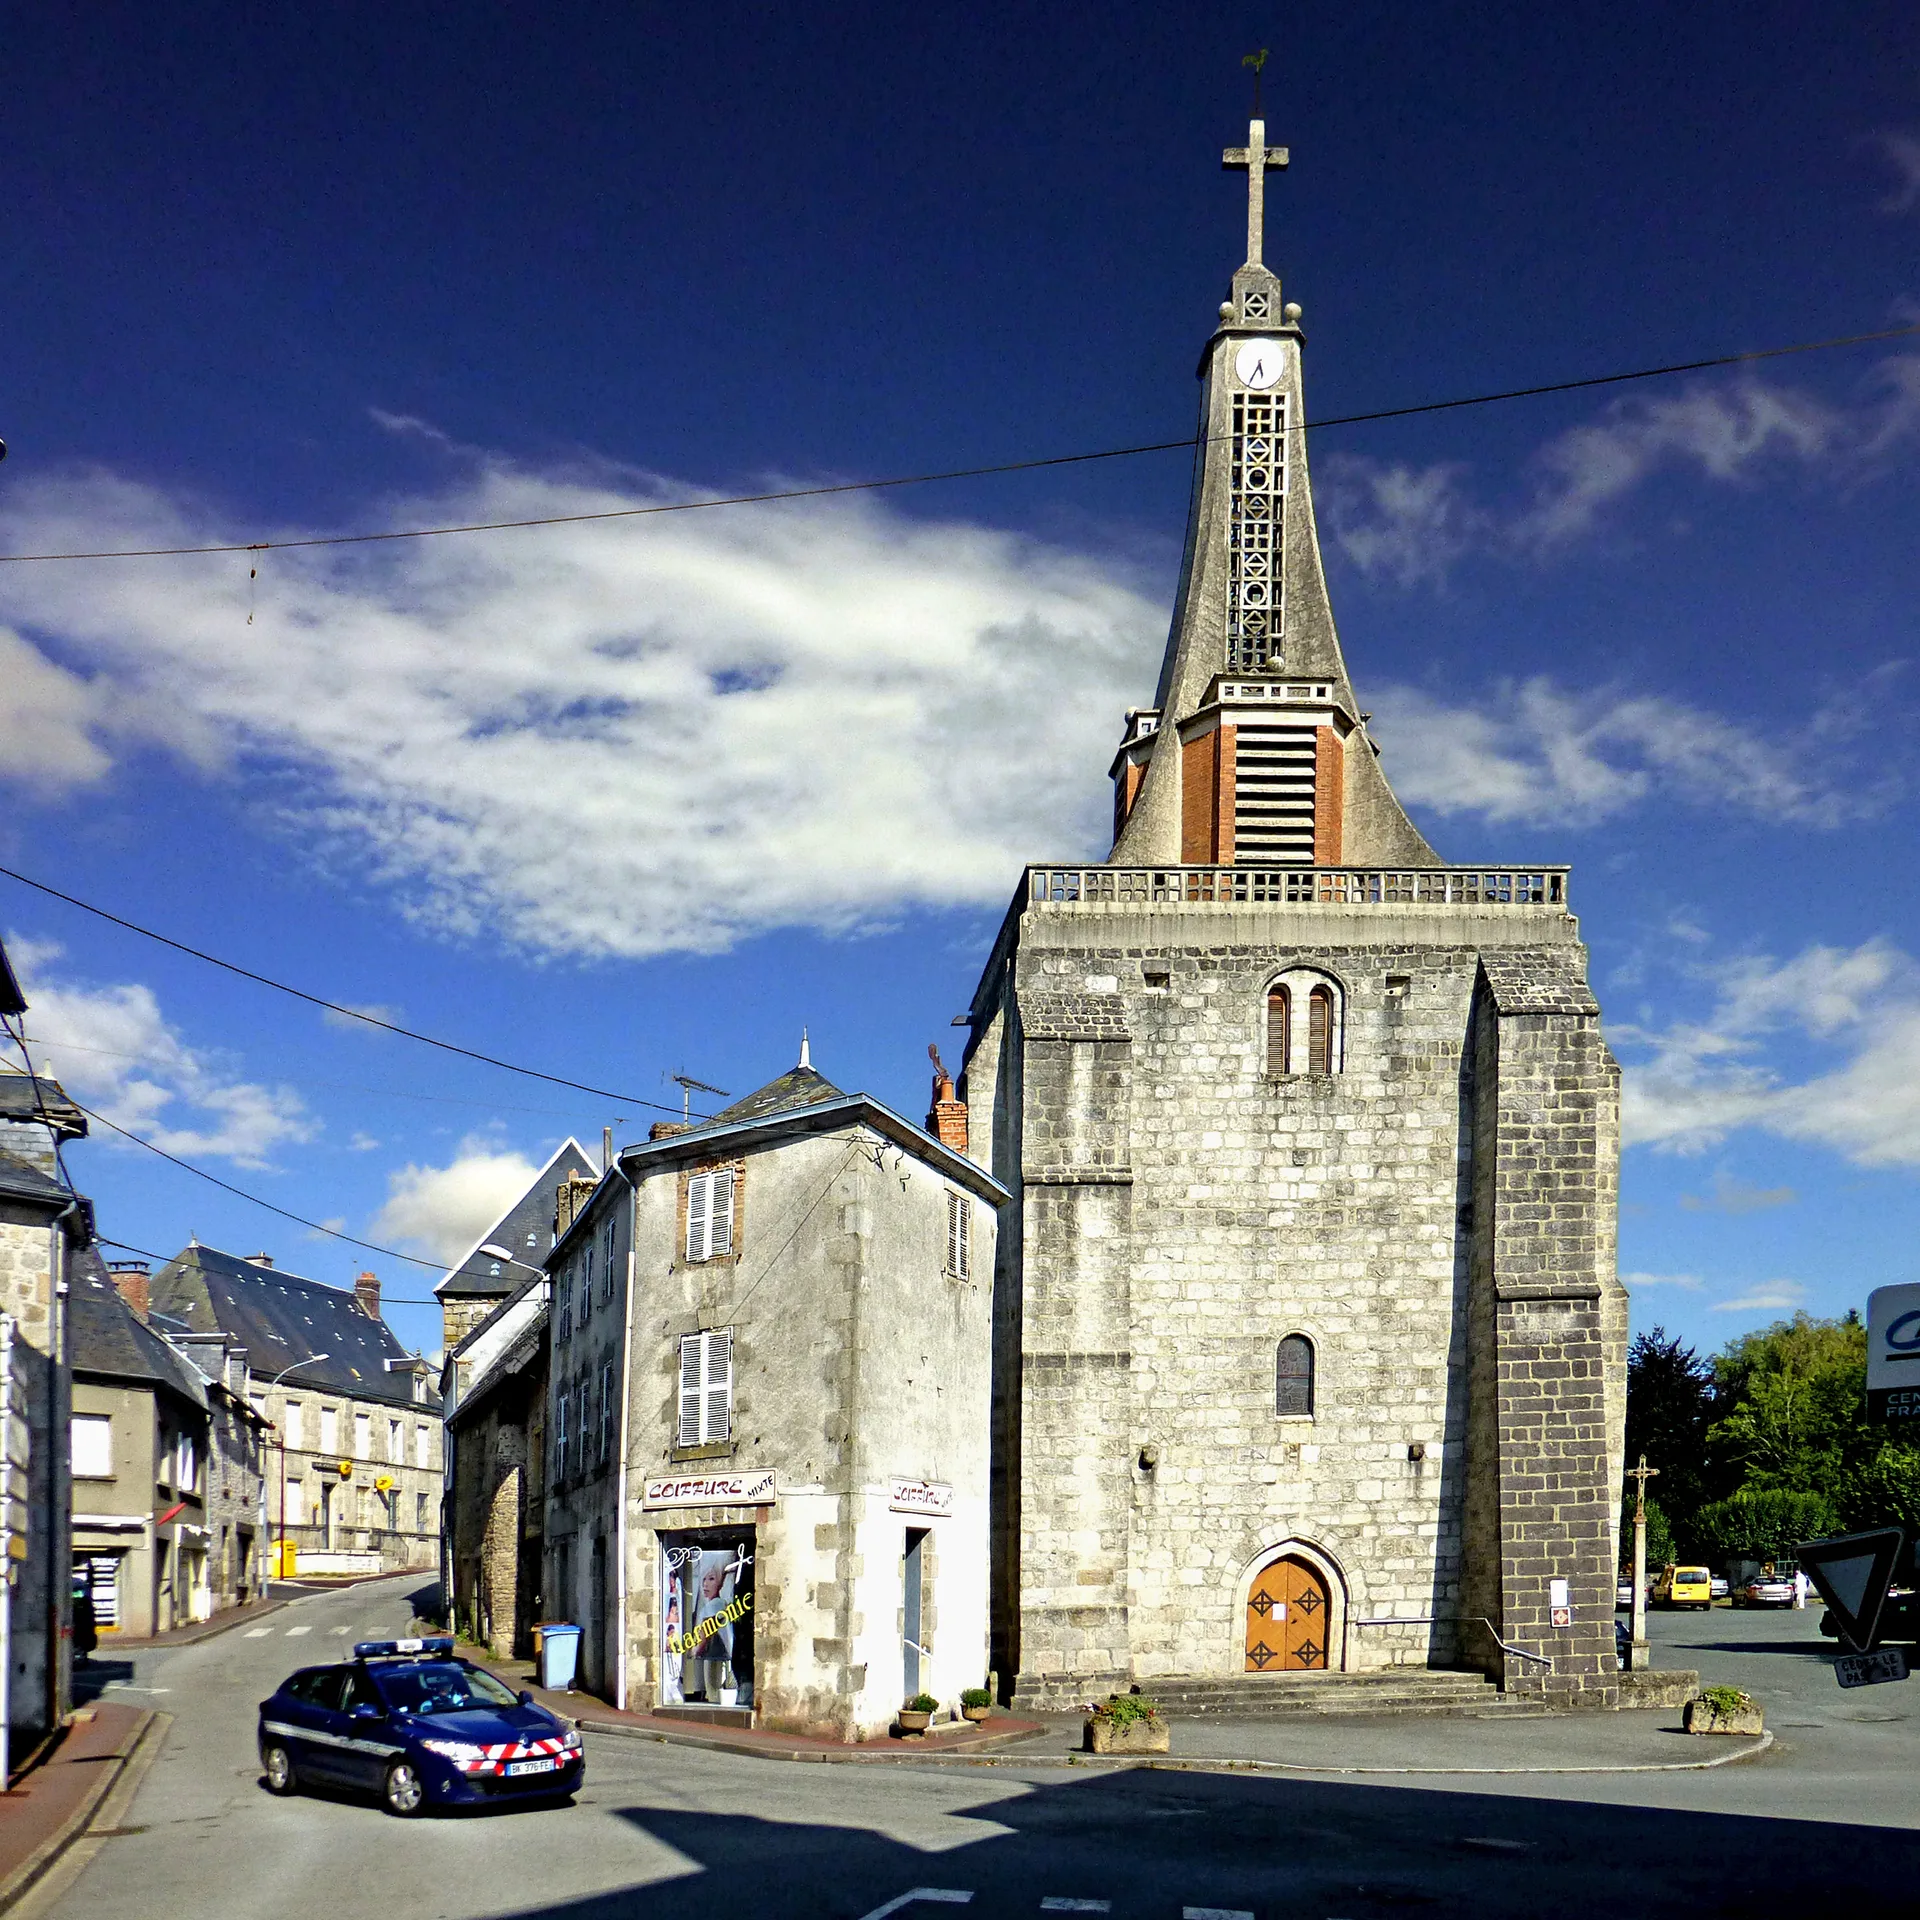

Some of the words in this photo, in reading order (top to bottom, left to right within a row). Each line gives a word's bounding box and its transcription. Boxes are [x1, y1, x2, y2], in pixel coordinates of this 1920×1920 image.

[649, 1480, 742, 1499] COIFFURE
[747, 1475, 774, 1499] MIXTE
[1882, 1653, 1898, 1665] LE
